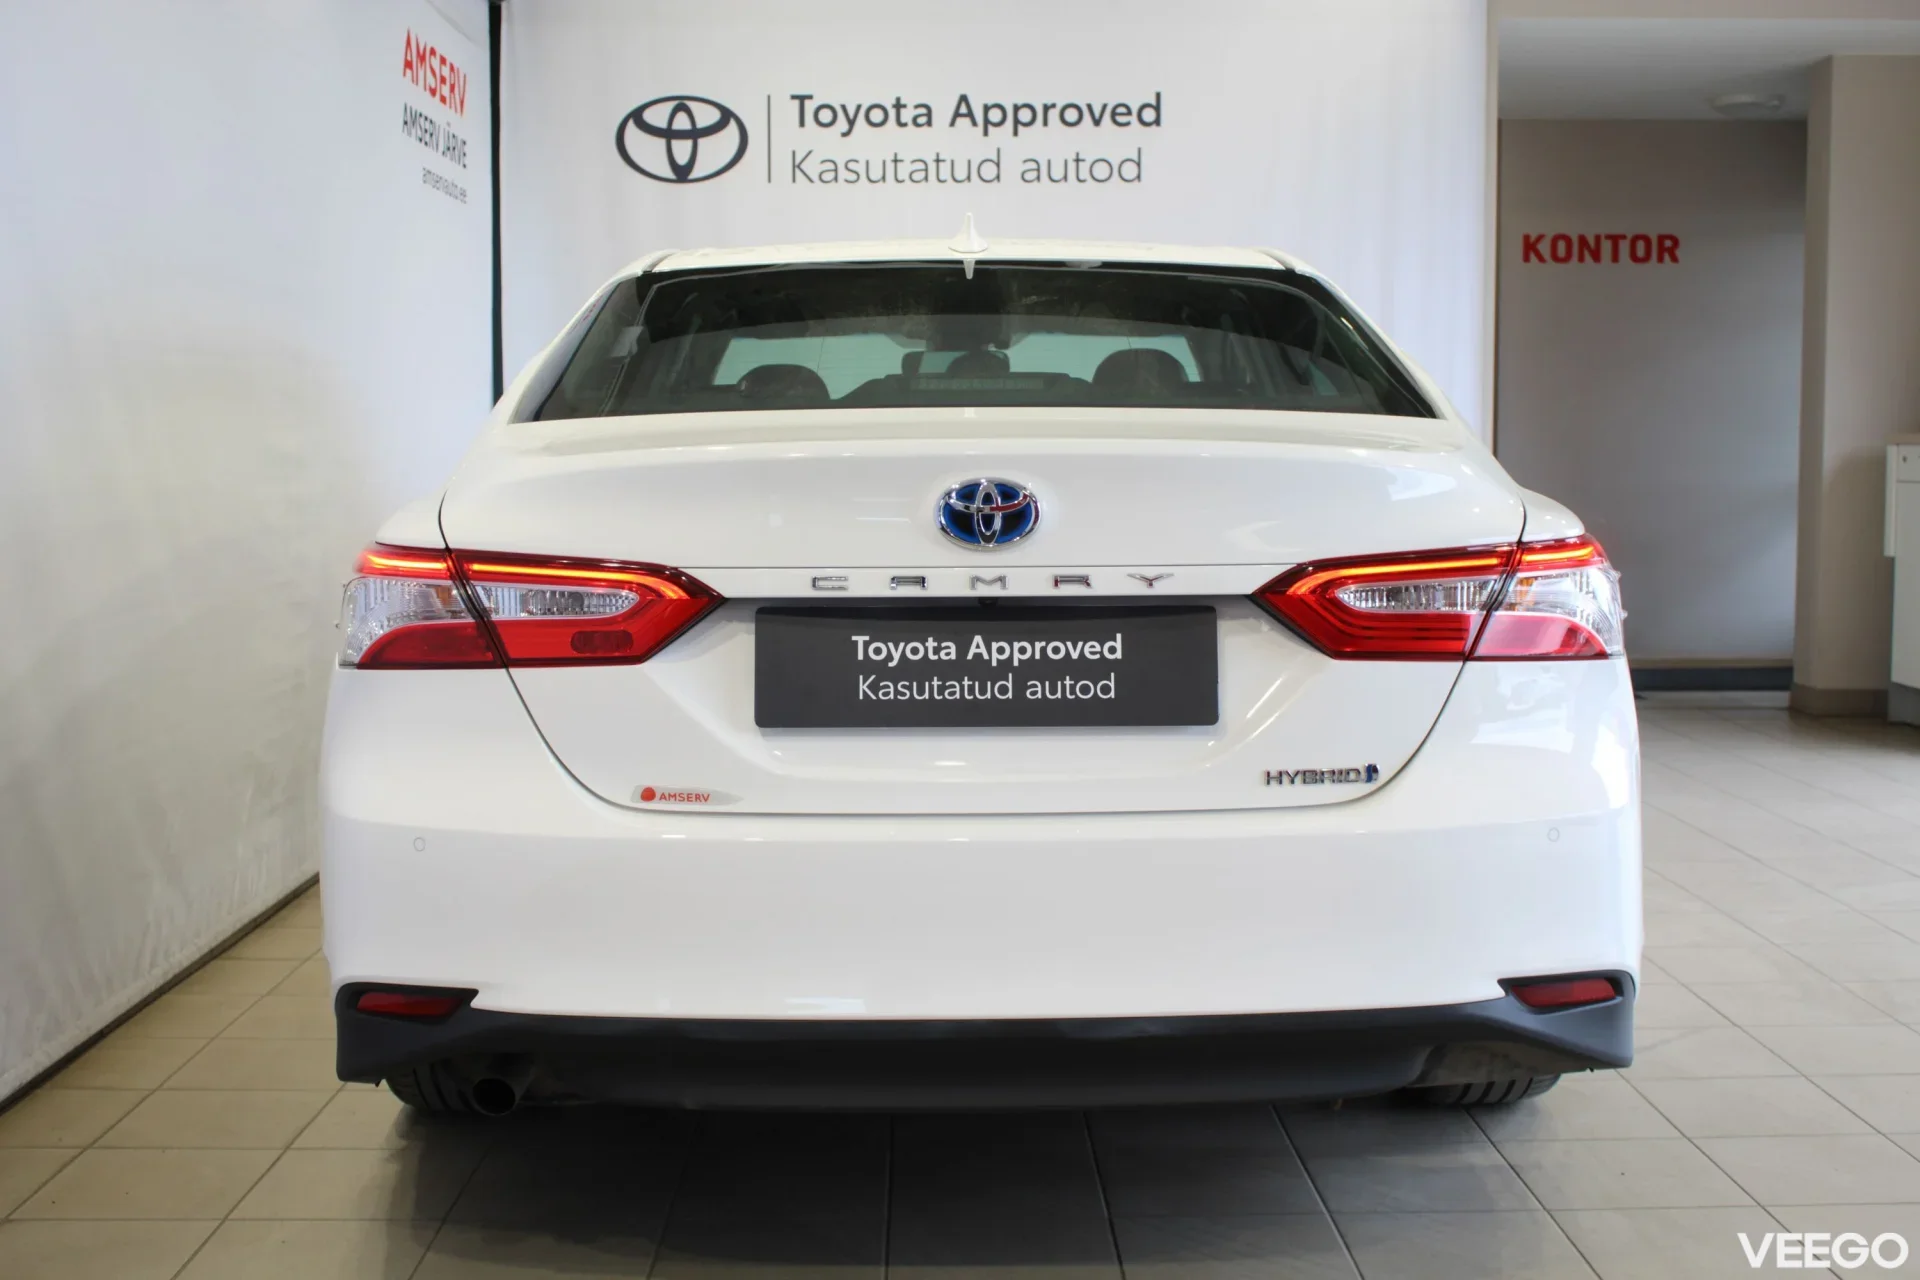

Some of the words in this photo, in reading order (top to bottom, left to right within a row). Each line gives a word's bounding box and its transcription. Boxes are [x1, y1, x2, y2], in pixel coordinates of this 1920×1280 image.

[403, 27, 467, 117] AMSERV
[790, 94, 933, 137] Toyota
[949, 92, 1162, 137] Approved
[402, 102, 441, 153] AMSERV
[441, 121, 467, 169] JÄRVE
[791, 147, 1001, 184] Kasutatud
[1020, 148, 1143, 183] autod
[1522, 233, 1680, 263] KONTOR
[811, 573, 1174, 591] CAMRY
[852, 636, 956, 666] Toyota
[966, 634, 1123, 666] Approved
[858, 674, 1013, 700] Kasutatud
[1025, 674, 1115, 699] autod
[1265, 768, 1361, 785] HYBRID
[658, 792, 711, 803] AMSERV
